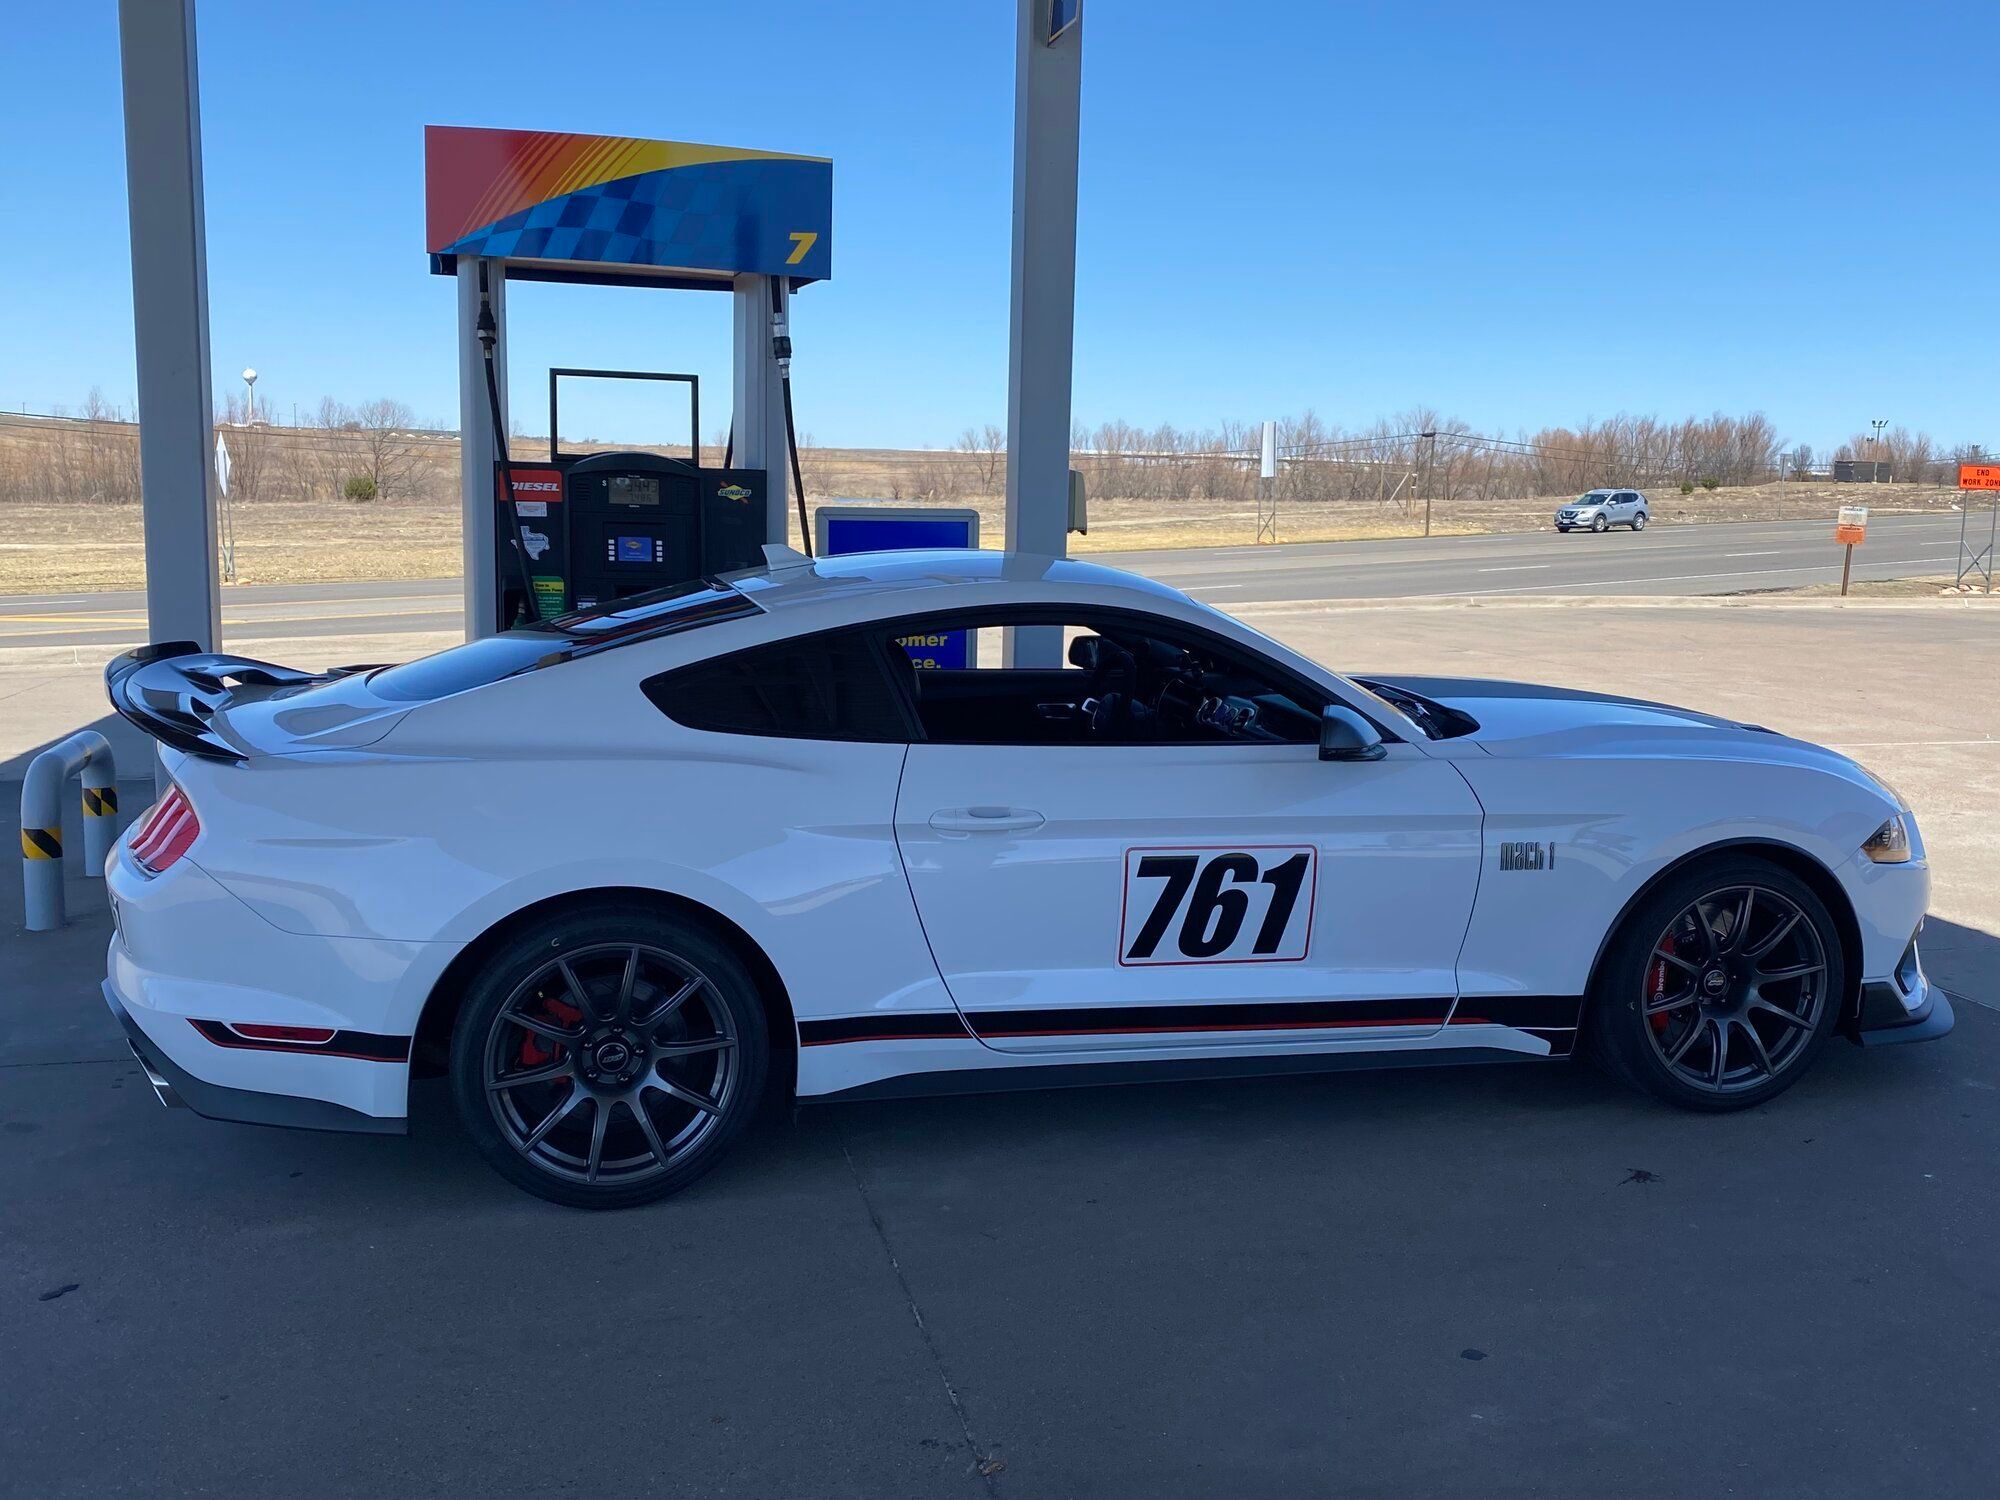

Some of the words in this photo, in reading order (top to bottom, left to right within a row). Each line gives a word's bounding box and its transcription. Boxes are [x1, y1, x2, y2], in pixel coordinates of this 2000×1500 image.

[785, 232, 818, 264] 7
[601, 479, 608, 488] $
[718, 488, 752, 497] SUNOCO
[1963, 478, 1982, 486] WORK
[1549, 841, 1555, 871] 1
[1126, 852, 1310, 958] 761
[1656, 960, 1666, 991] brembo
